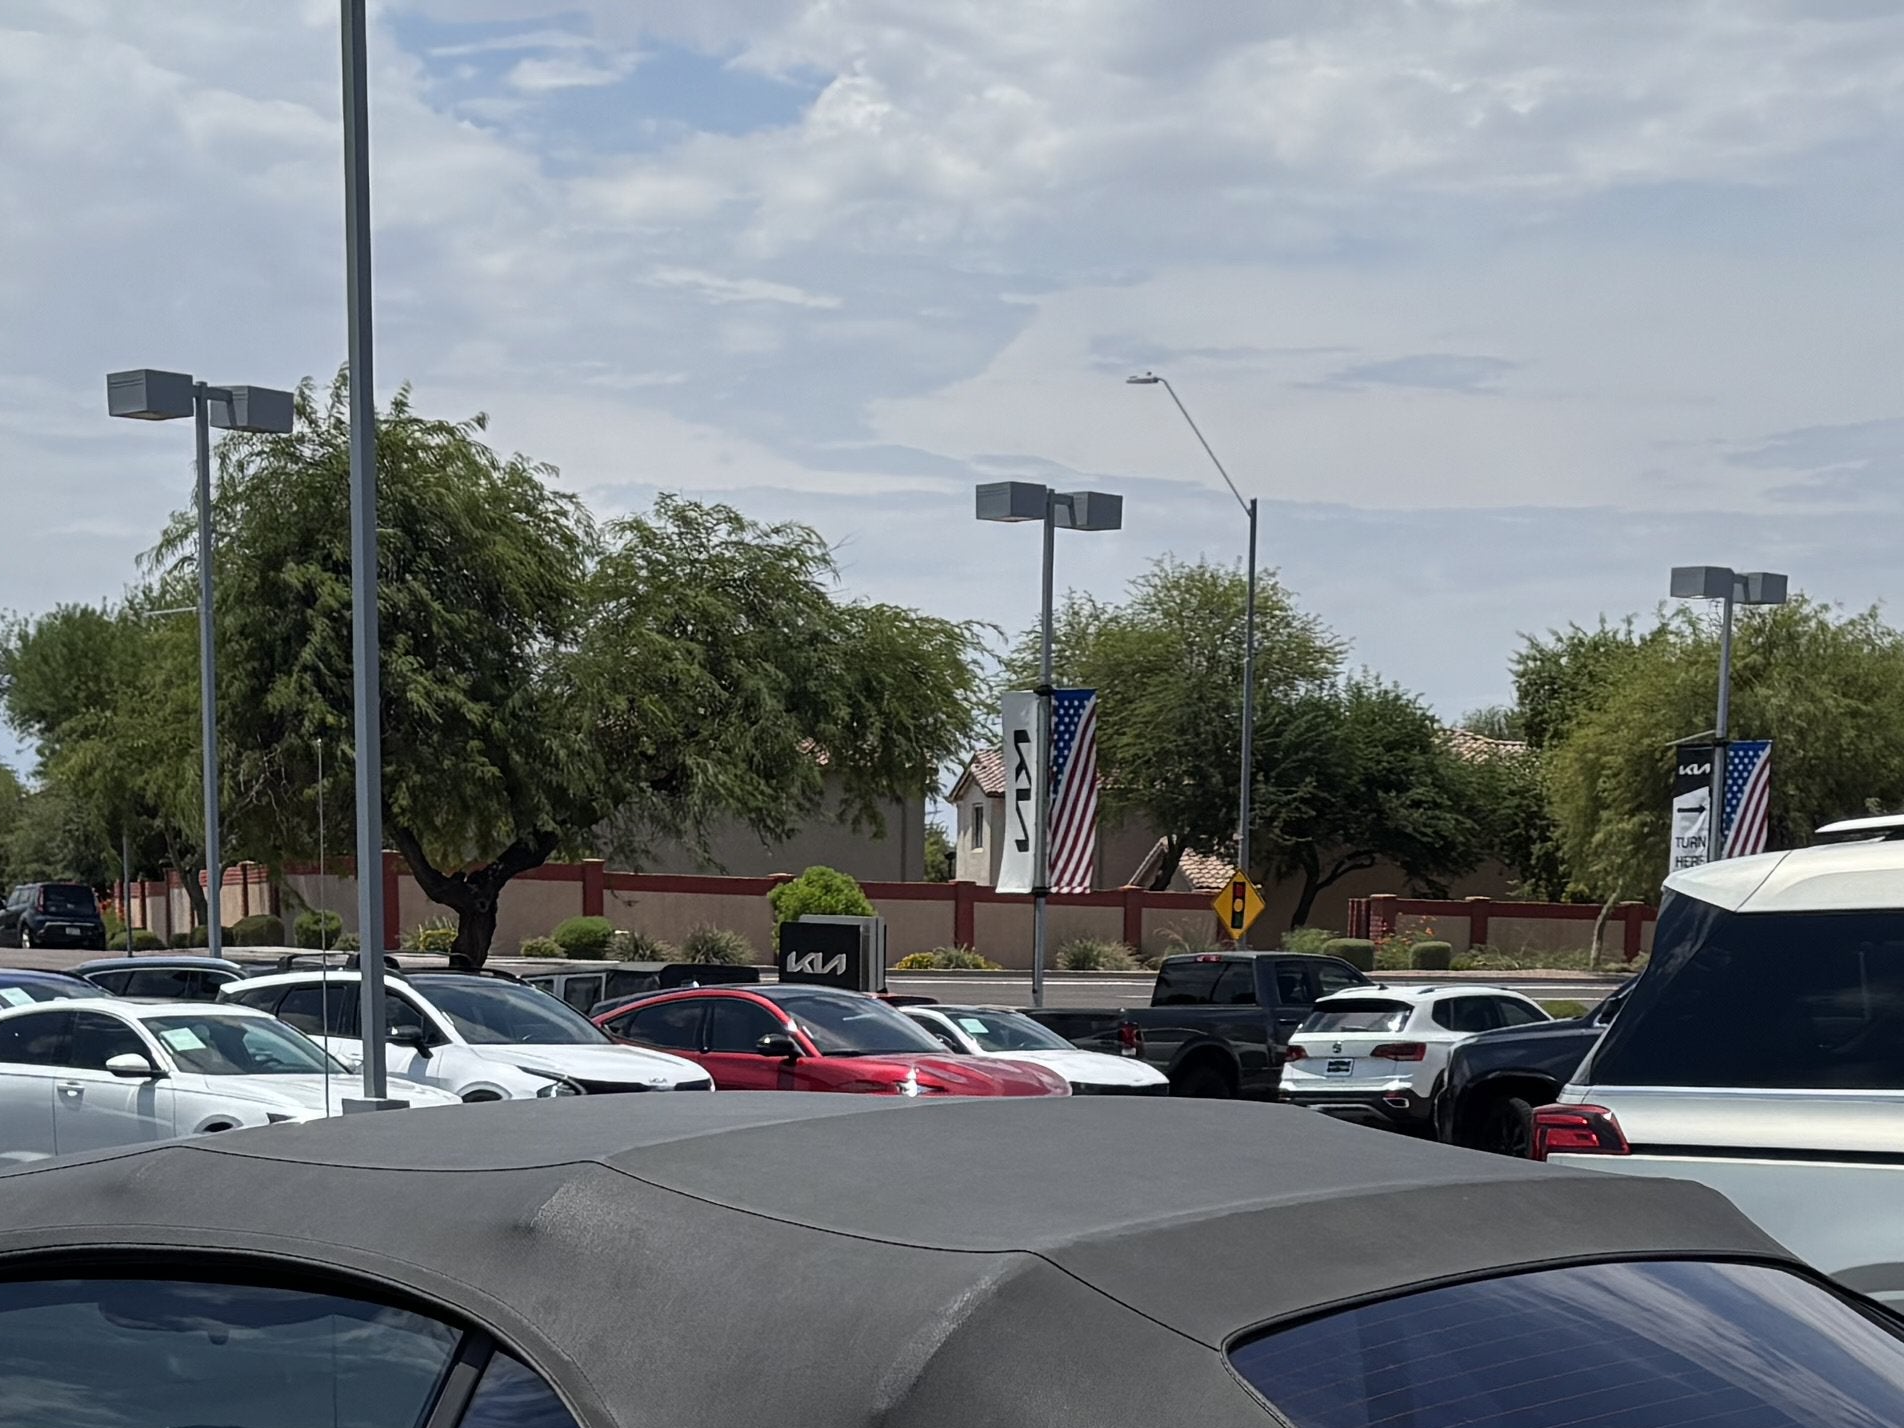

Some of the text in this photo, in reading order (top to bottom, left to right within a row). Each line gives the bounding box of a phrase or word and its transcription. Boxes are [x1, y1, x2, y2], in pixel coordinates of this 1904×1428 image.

[1678, 763, 1711, 776] KIA
[1675, 836, 1706, 849] TURN
[1674, 855, 1705, 868] HERE
[786, 951, 847, 975] KIA
